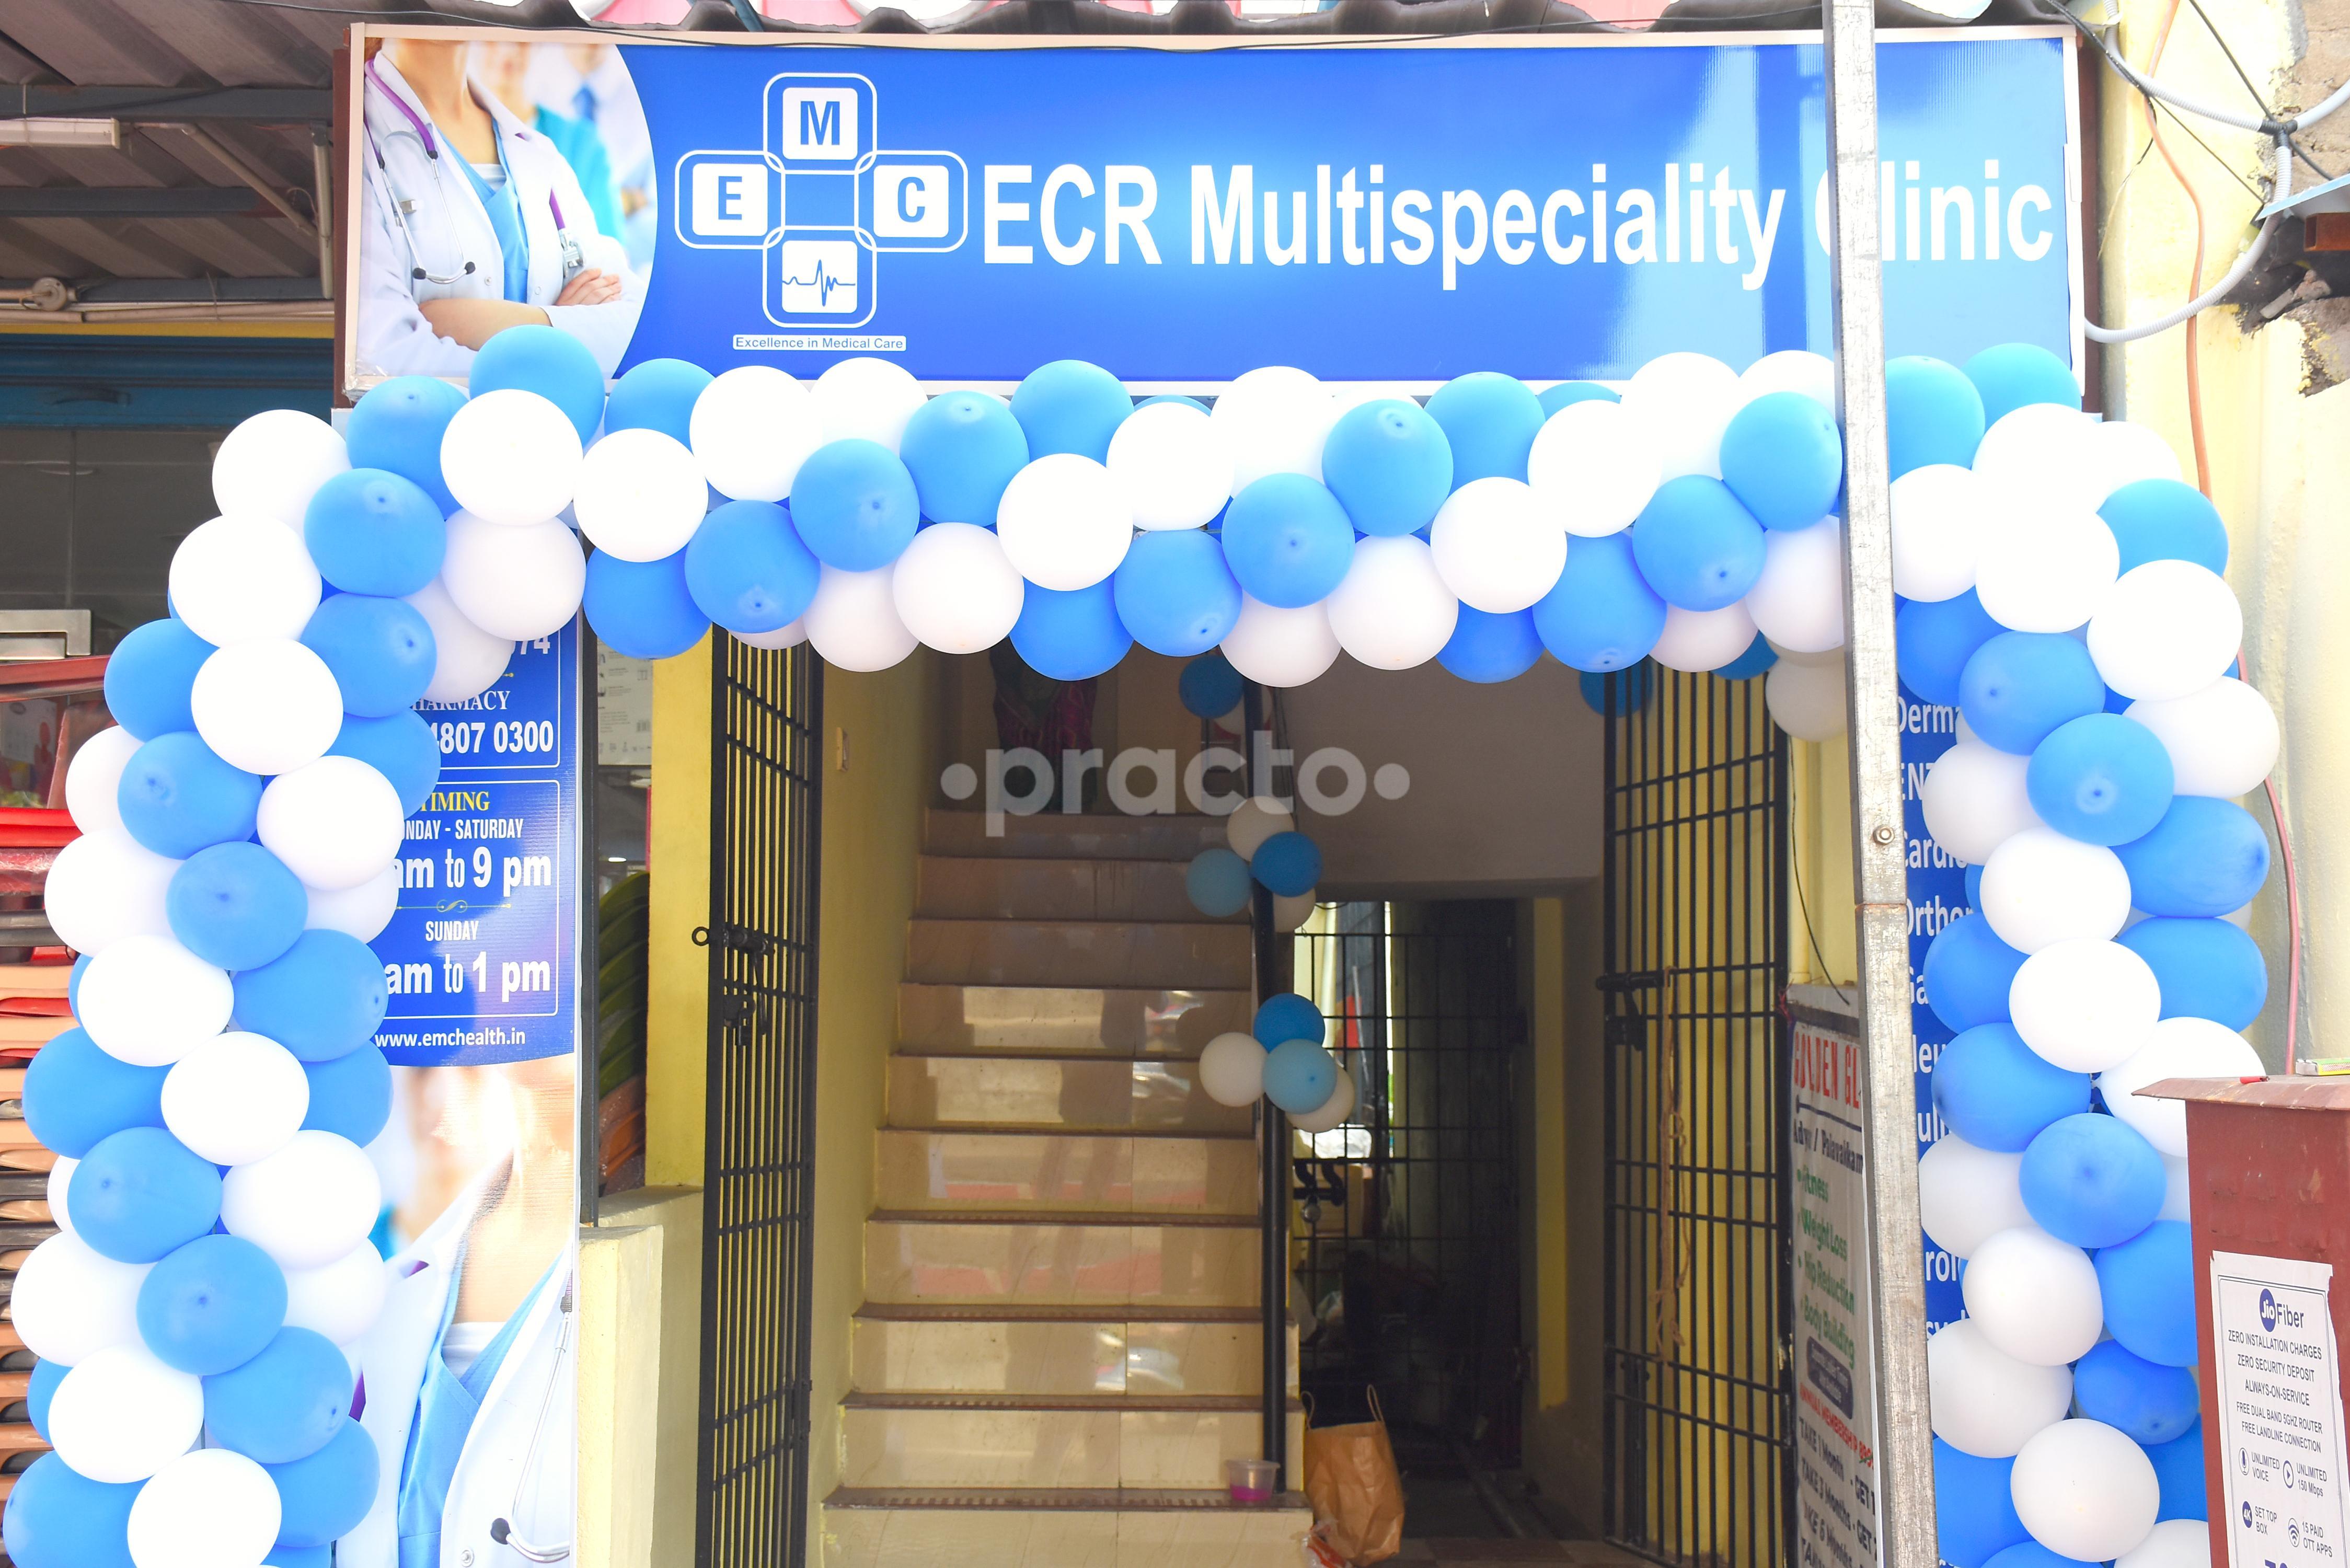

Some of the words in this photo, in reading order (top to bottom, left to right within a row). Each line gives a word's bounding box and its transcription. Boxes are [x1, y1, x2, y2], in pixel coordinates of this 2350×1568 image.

[800, 100, 840, 146] M
[717, 176, 743, 220] E
[896, 176, 926, 223] C
[984, 164, 1162, 265] ECR
[1191, 163, 1786, 291] Multispeciality
[1815, 159, 2054, 261] linic
[735, 337, 804, 348] Excellence
[808, 337, 819, 348] in
[822, 337, 870, 349] Medical
[874, 338, 903, 349] Care
[493, 720, 554, 753] 0300
[402, 819, 442, 840] NDAY
[455, 818, 524, 839] SATURDAY
[445, 848, 465, 889] to
[473, 846, 492, 889] 9
[503, 855, 551, 897] pm
[425, 920, 479, 942] SUNDAY
[384, 962, 433, 995] am
[443, 953, 464, 994] to
[473, 951, 487, 993] 1
[502, 960, 550, 1003] pm
[374, 1027, 526, 1048] www.emchealth.in
[2276, 1302, 2305, 1329] Fiber
[2228, 1329, 2245, 1344] ZERO
[2245, 1333, 2289, 1354] INSTALLATION
[2289, 1341, 2322, 1361] CHARGES
[2237, 1354, 2254, 1368] ZERO
[2255, 1357, 2286, 1376] SECURITY
[2287, 1364, 2315, 1382] DEPOSIT
[2245, 1379, 2310, 1406] ALWAYS-ON-SERVICE
[2236, 1401, 2250, 1415] FREE
[2251, 1404, 2266, 1419] DUAL
[2266, 1409, 2283, 1423] BAND
[2283, 1413, 2298, 1427] 5GHZ
[2298, 1417, 2323, 1435] ROUTER
[2241, 1421, 2256, 1435] FREE
[2256, 1424, 2284, 1443] LANDLINE
[2284, 1432, 2322, 1454] CONNECTION
[2251, 1451, 2280, 1470] UNLIMITED
[2296, 1462, 2328, 1482] UNLIMITED
[2252, 1466, 2270, 1482] VOICE
[2297, 1478, 2307, 1492] 150
[2308, 1482, 2324, 1498] Mbps
[2243, 1508, 2252, 1522] 4K
[2254, 1505, 2265, 1519] SET
[2265, 1509, 2277, 1524] TOP
[2255, 1521, 2268, 1536] BOX
[2302, 1520, 2309, 1534] 15
[2309, 1521, 2324, 1538] PAID
[2302, 1537, 2315, 1551] OTT
[2316, 1542, 2333, 1558] APPS
